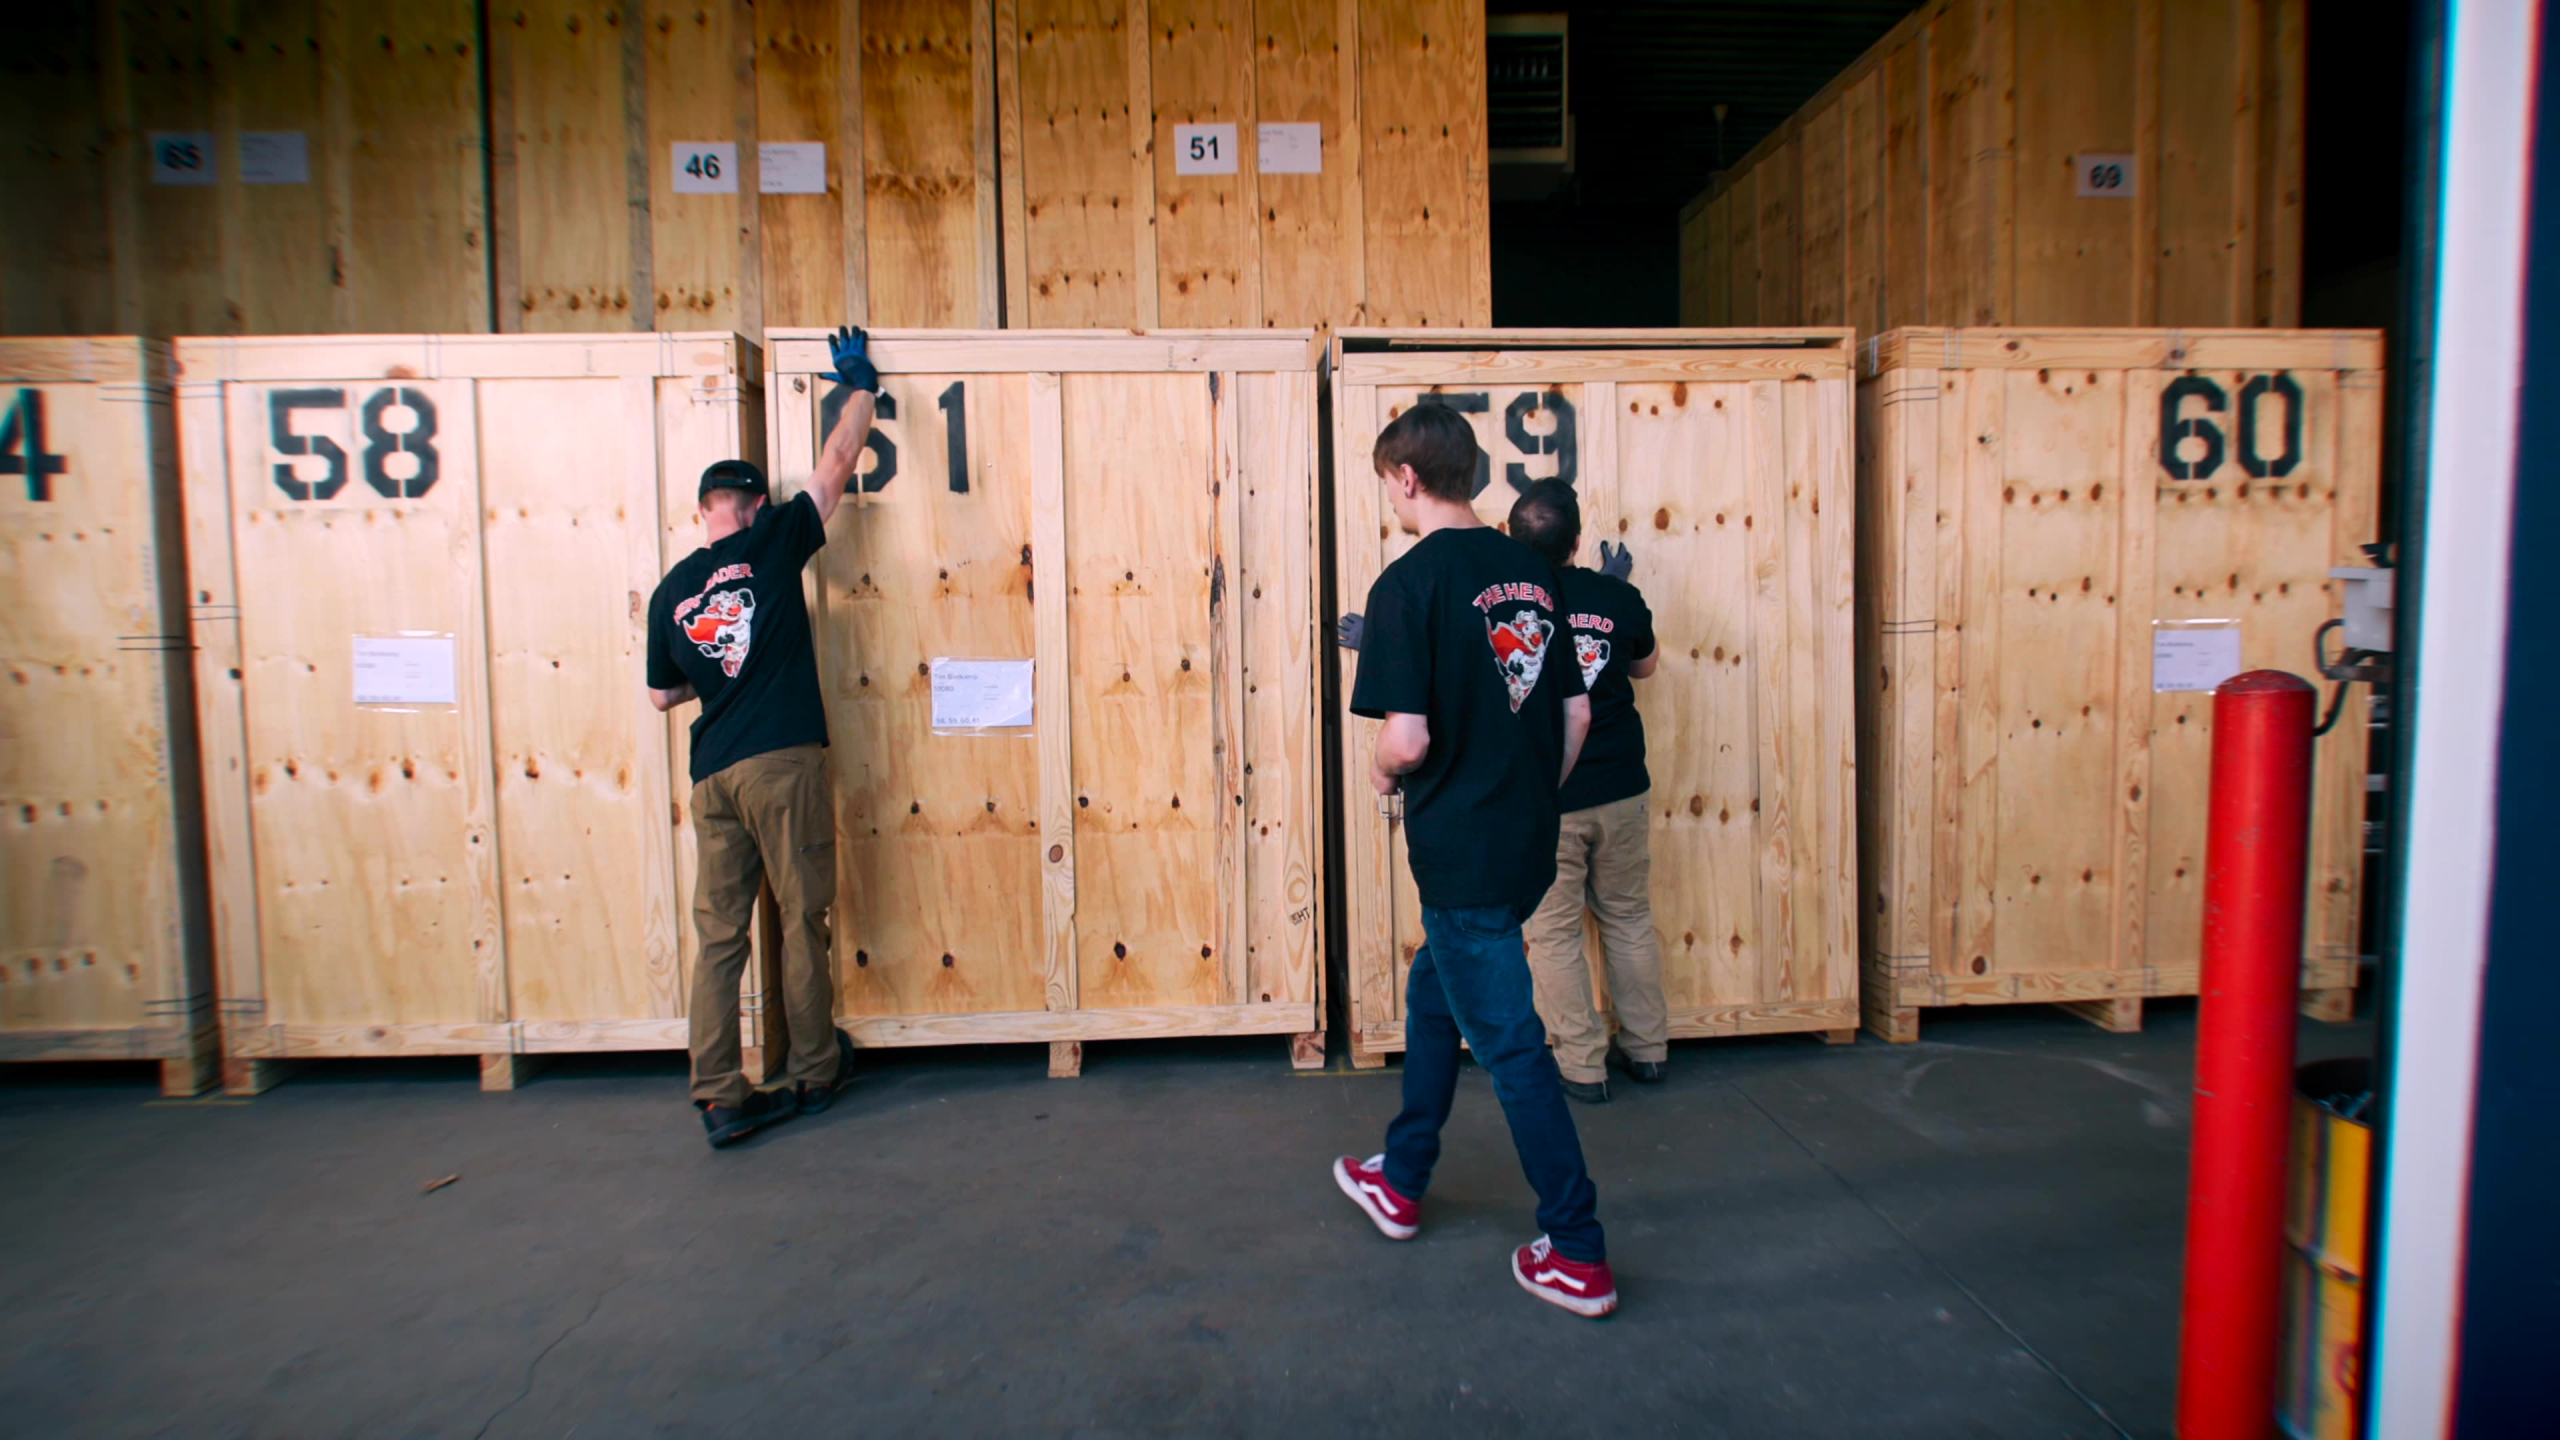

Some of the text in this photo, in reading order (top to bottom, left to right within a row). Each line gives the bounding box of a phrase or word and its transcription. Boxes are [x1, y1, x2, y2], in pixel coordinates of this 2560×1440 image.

[685, 153, 721, 179] 46
[1190, 135, 1219, 161] 51
[2090, 164, 2123, 189] 69
[0, 387, 69, 502] 4
[269, 386, 441, 501] 58
[821, 381, 970, 494] 61
[2158, 372, 2305, 480] 60
[1472, 583, 1506, 614] THE
